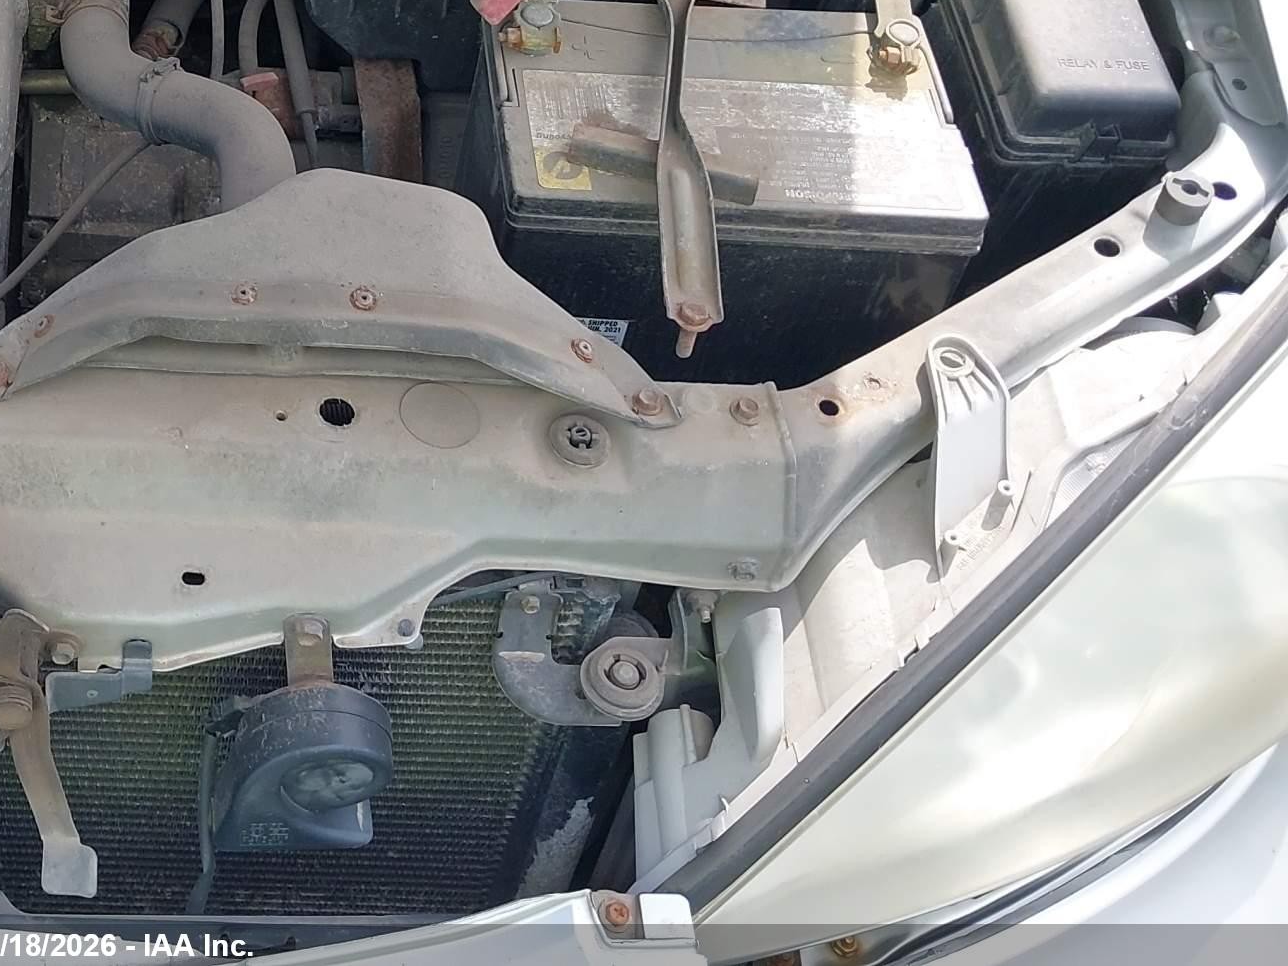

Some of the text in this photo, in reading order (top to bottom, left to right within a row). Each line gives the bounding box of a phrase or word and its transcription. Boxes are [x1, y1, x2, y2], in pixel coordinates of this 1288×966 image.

[1058, 58, 1097, 69] RELAY
[1116, 60, 1150, 71] FUSE
[588, 319, 618, 327] SHIPPED
